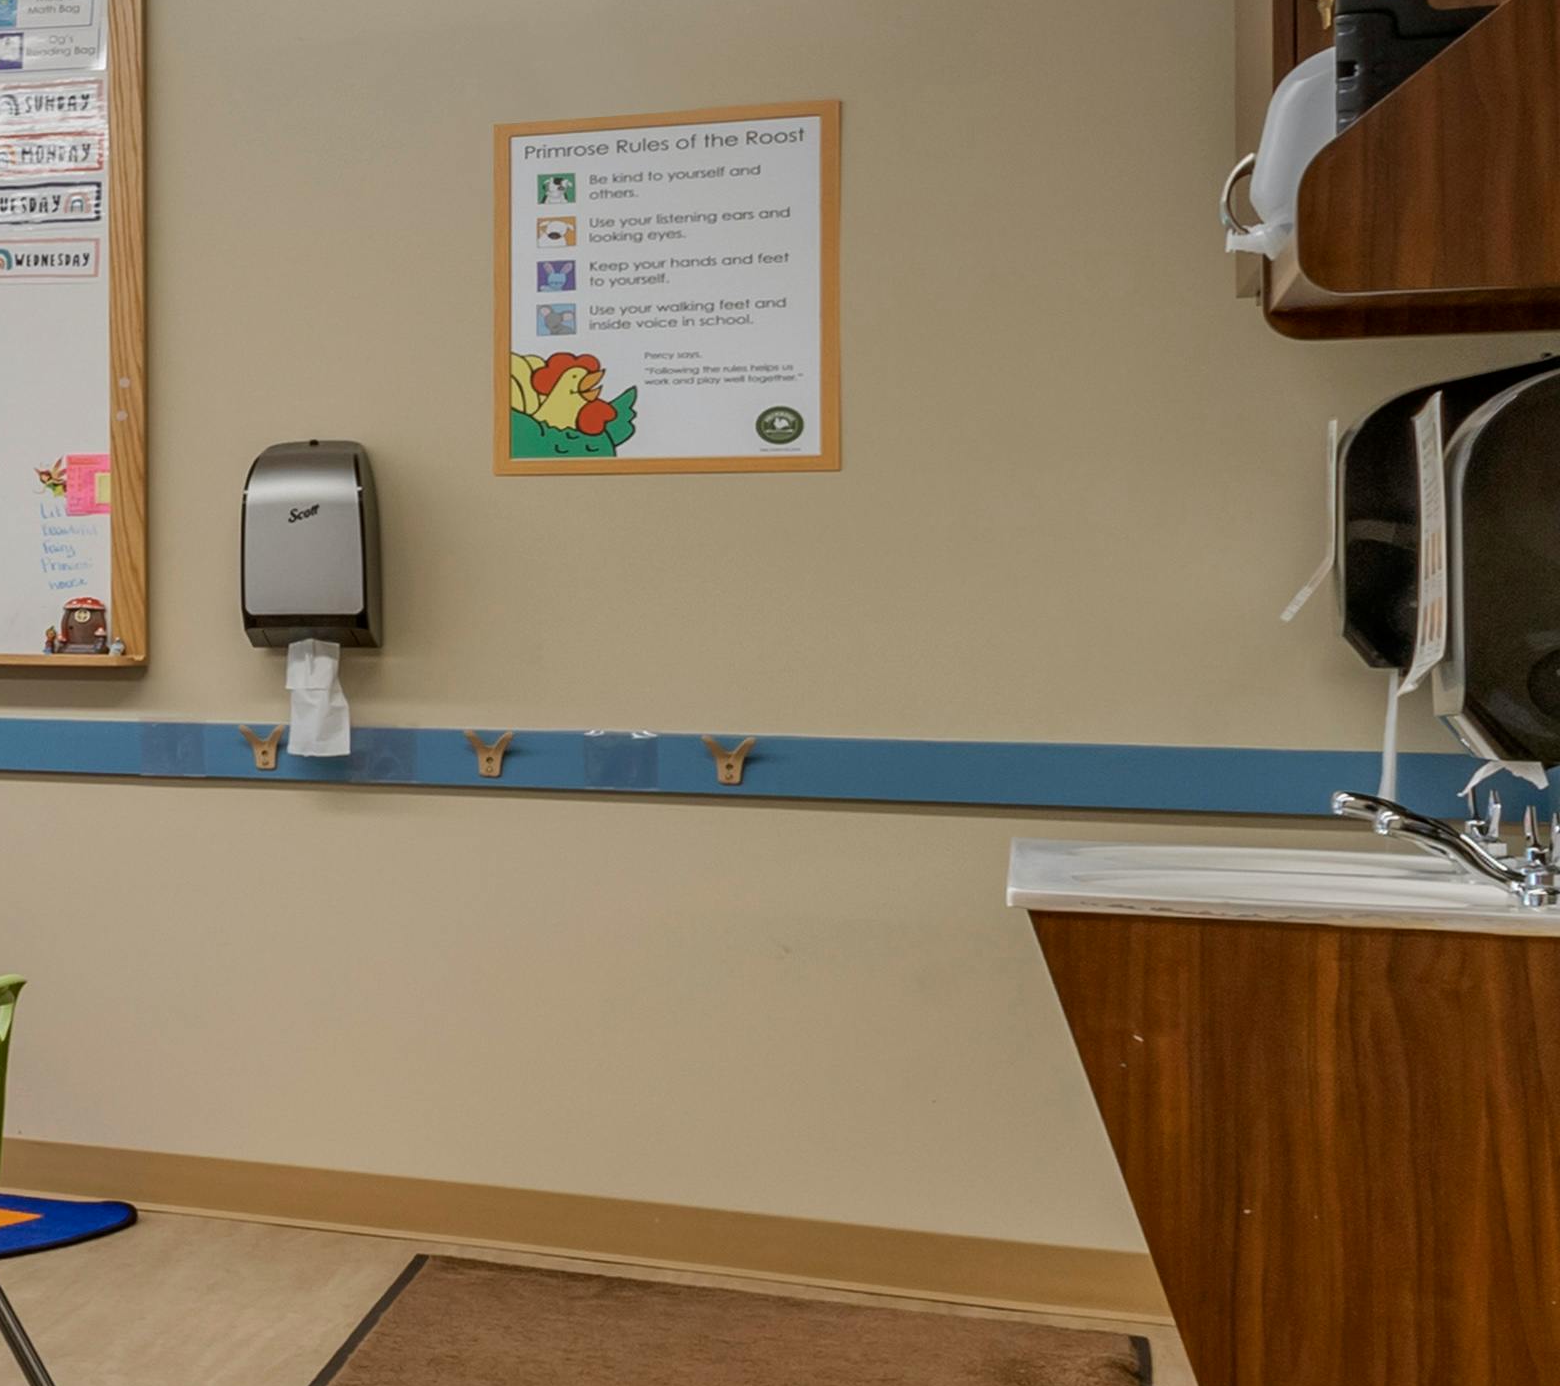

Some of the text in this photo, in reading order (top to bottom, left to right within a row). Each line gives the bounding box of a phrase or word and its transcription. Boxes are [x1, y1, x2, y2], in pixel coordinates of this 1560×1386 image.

[58, 3, 81, 15] Bag
[73, 44, 97, 55] Bag
[523, 126, 805, 160] Primrose Rules of the Roost
[588, 164, 762, 185] Be kind to yourself and
[588, 206, 791, 229] Use your listening ears and
[588, 229, 687, 243] looking eyes.
[14, 252, 90, 267] WEDNESDAY
[589, 251, 791, 273] Keep your hands and feet
[589, 272, 670, 288] to yourself.
[589, 297, 788, 317] Use your walking feet and
[588, 313, 754, 331] inside voice in school.
[702, 364, 721, 374] the
[671, 376, 696, 385] and
[696, 375, 721, 386] play
[723, 374, 746, 384] well
[287, 503, 320, 524] Scott
